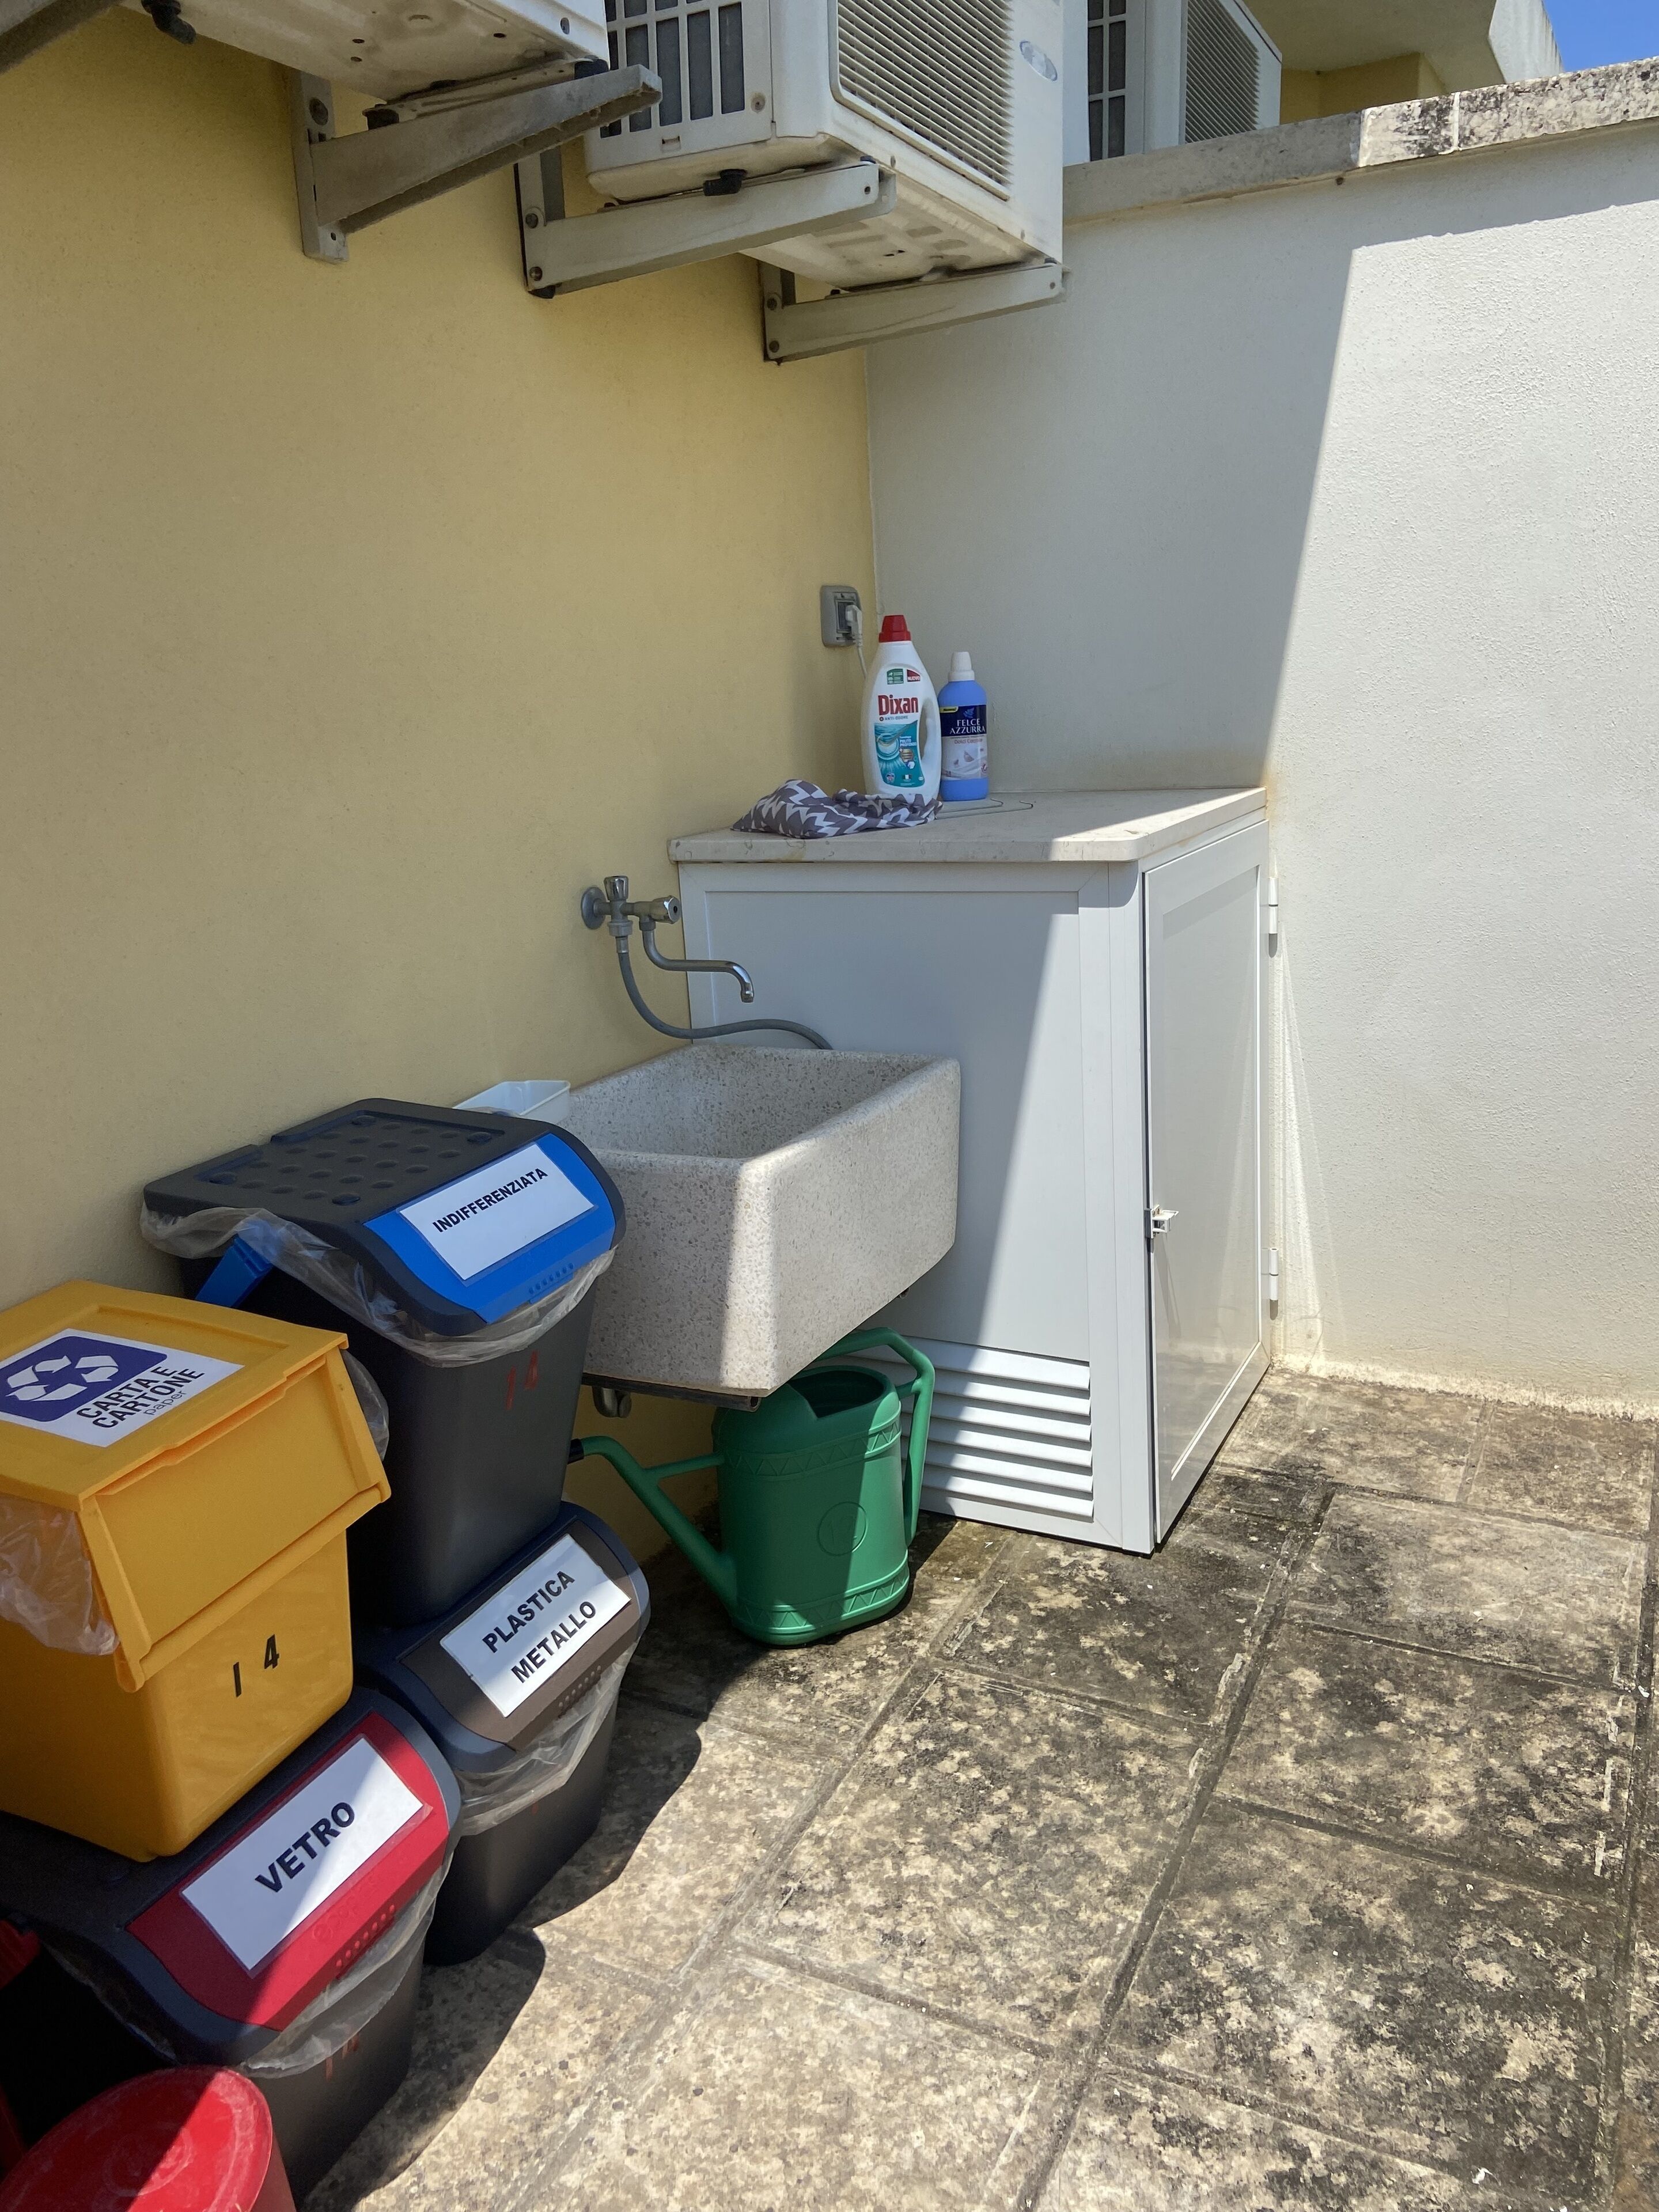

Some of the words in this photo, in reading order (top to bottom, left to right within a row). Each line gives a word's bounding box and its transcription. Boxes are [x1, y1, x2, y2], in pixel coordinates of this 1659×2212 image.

[878, 694, 919, 715] Dixan
[949, 726, 986, 734] AZZURRA
[957, 718, 980, 726] FELCE
[432, 1168, 548, 1233] INDIFFERENZIATA
[76, 1378, 161, 1419] CARTA
[150, 1366, 178, 1377] E
[92, 1369, 205, 1428] CARTONE
[143, 1390, 187, 1416] paper
[482, 1570, 575, 1653] PLASTICA
[511, 1601, 596, 1683] METALLO
[254, 1802, 355, 1893] VETRO
